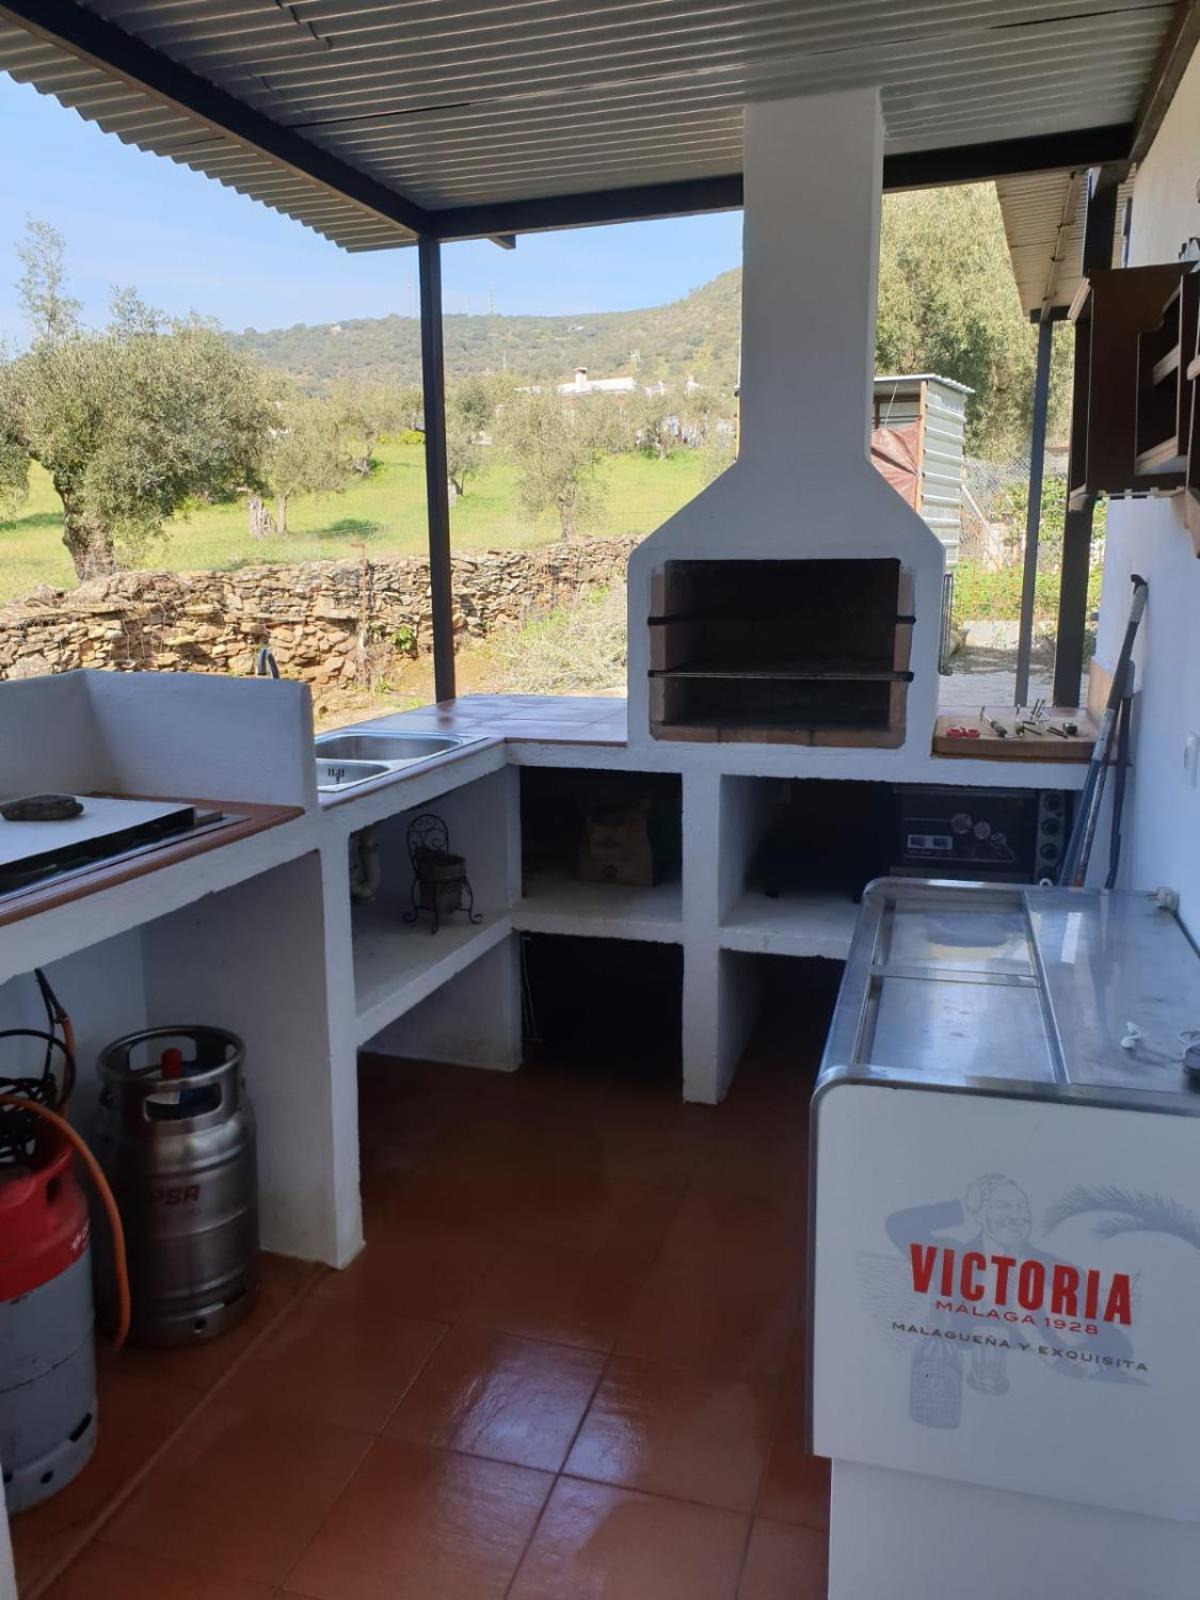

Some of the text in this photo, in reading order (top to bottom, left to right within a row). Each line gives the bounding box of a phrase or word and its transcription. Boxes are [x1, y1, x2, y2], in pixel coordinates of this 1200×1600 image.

[910, 1243, 1132, 1325] VICTORIA
[1045, 1316, 1098, 1335] 1928
[1018, 1342, 1030, 1351] Y
[1038, 1345, 1148, 1372] EXQUISITA
